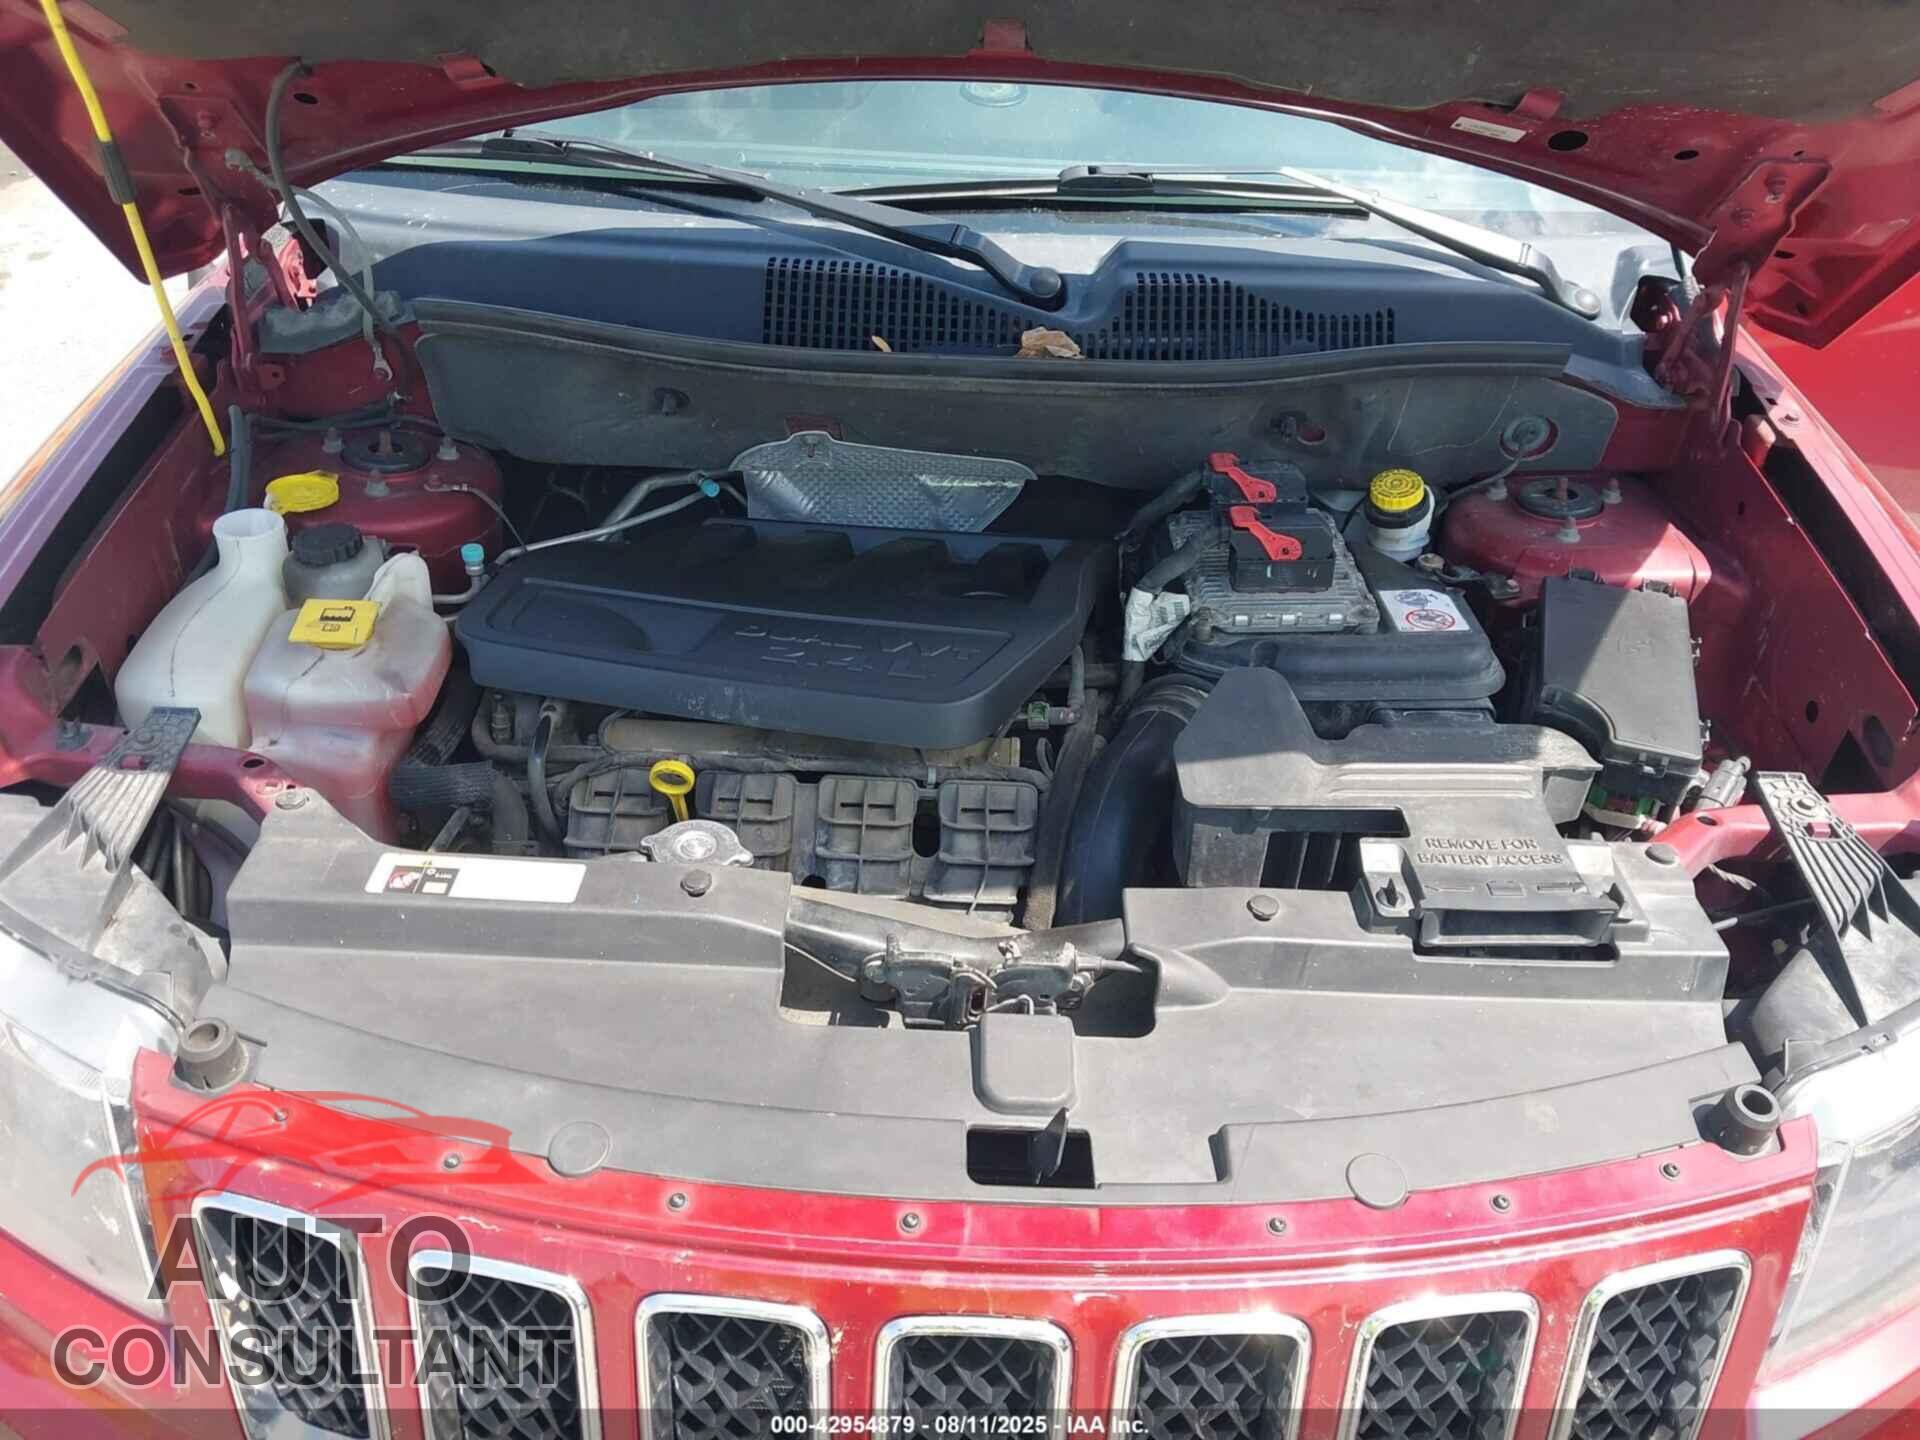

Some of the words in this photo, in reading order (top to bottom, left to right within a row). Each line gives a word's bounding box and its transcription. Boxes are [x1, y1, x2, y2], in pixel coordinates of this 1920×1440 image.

[1424, 837, 1498, 850] REMOVE
[1501, 839, 1538, 850] FOR
[1416, 852, 1489, 865] BATTERY
[1496, 854, 1563, 865] ACCESS
